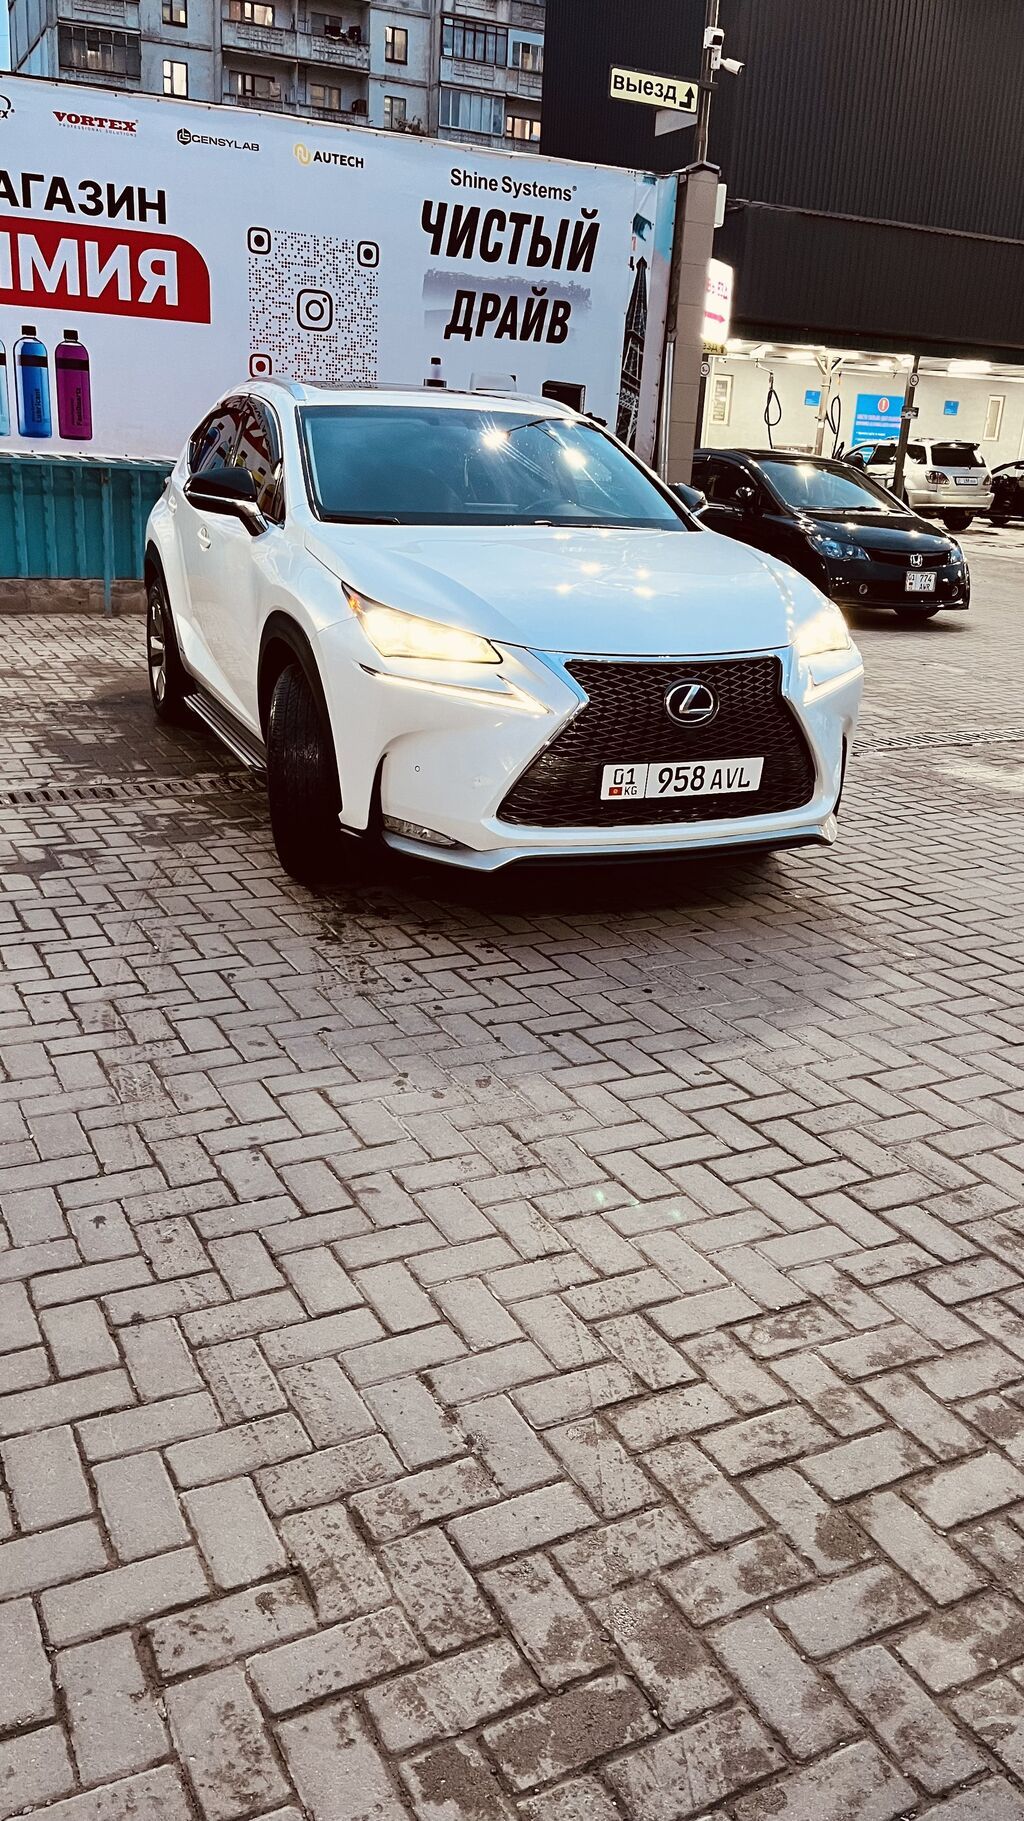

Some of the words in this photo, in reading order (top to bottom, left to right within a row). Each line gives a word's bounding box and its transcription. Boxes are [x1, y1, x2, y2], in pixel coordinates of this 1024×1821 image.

[613, 74, 677, 105] выезд
[53, 111, 137, 132] VORTEX
[59, 122, 102, 133] PROFESSIONAL
[105, 129, 138, 138] SOLUTIONS
[313, 150, 364, 169] AUTECH
[450, 168, 499, 192] Shine
[501, 176, 572, 202] Systems
[420, 199, 601, 273] ЧИСТЫЙ
[0, 231, 179, 307] МИЯ
[443, 286, 572, 345] ДРАЙВ
[613, 767, 636, 786] 01
[658, 765, 706, 794] 958
[709, 766, 751, 790] AVL
[623, 785, 638, 797] KG
